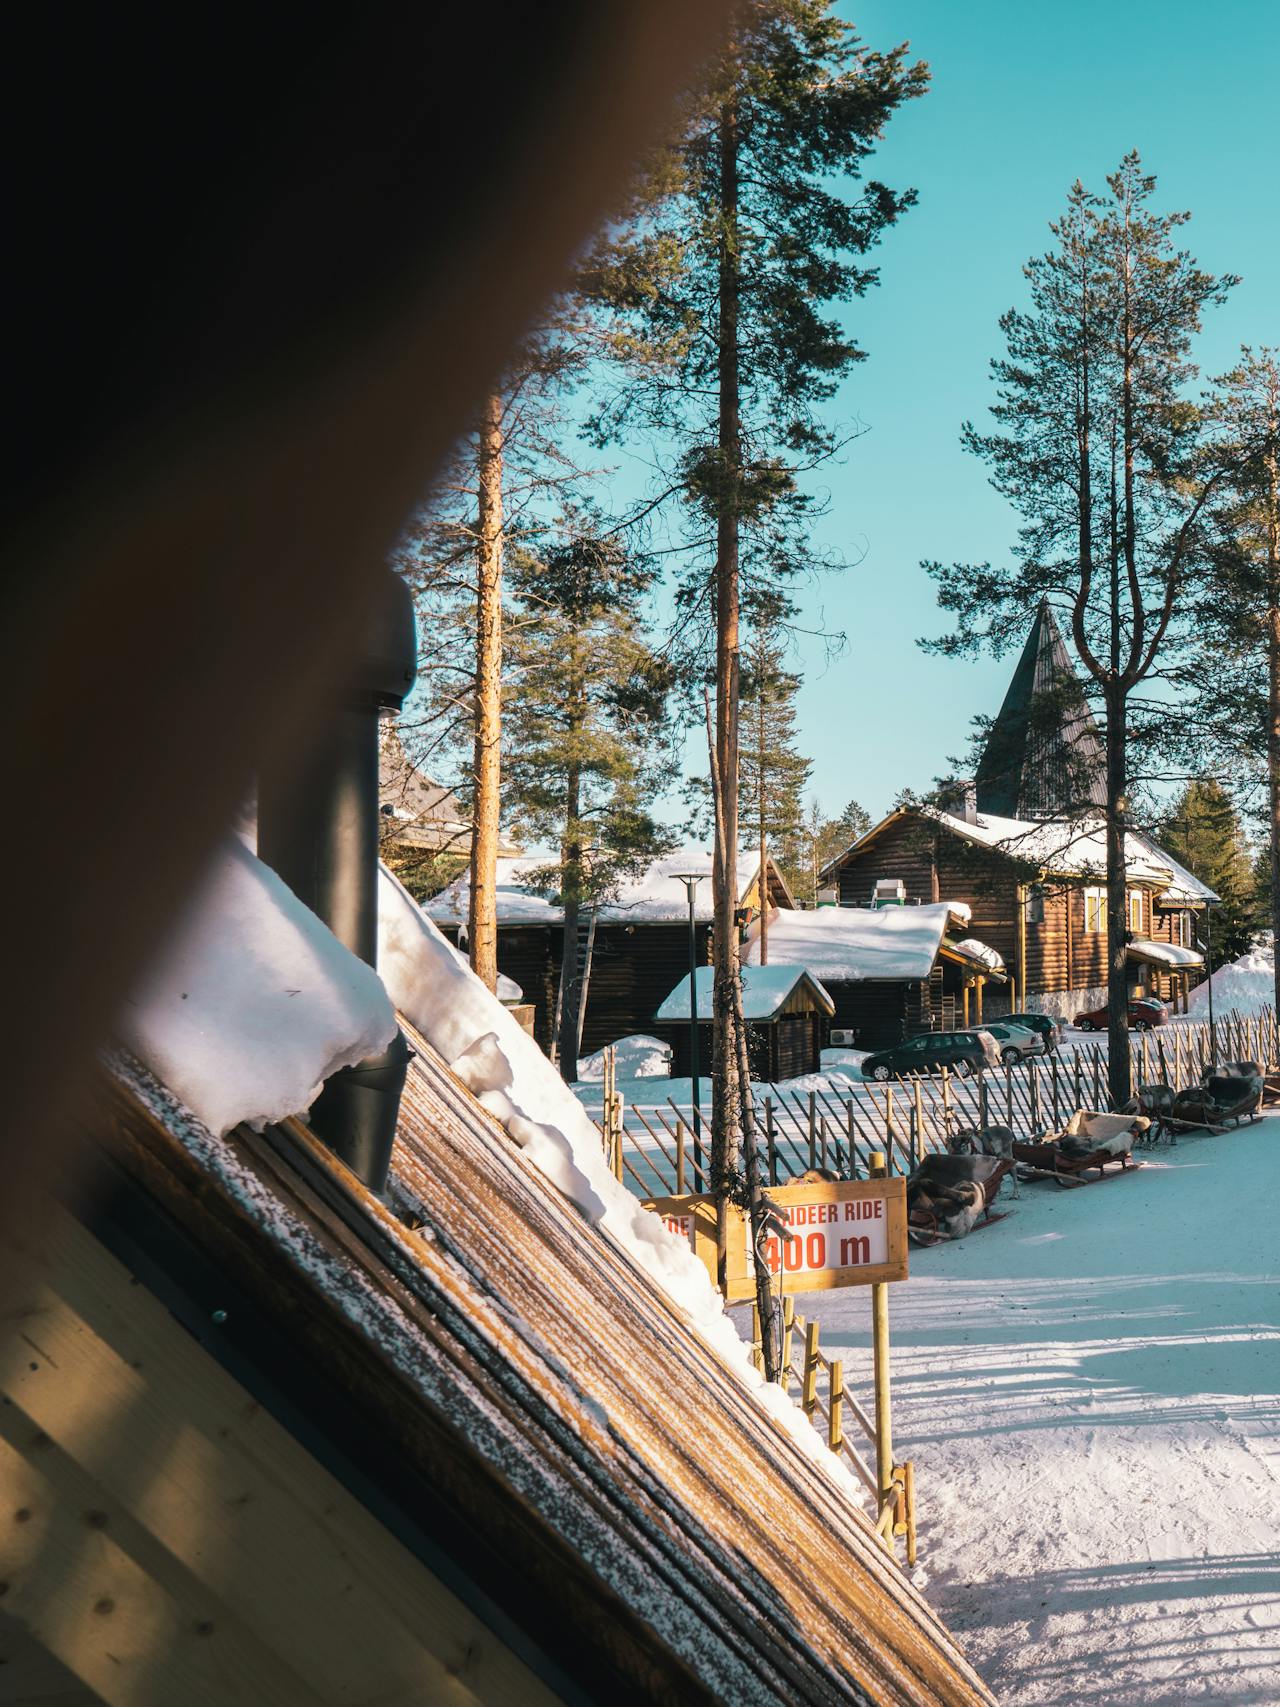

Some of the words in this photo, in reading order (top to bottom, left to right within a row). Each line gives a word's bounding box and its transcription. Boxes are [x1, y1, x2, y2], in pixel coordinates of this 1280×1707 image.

[768, 1204, 838, 1228] NDEER
[845, 1200, 882, 1221] RIDE
[766, 1232, 826, 1273] 400
[840, 1235, 871, 1266] m
